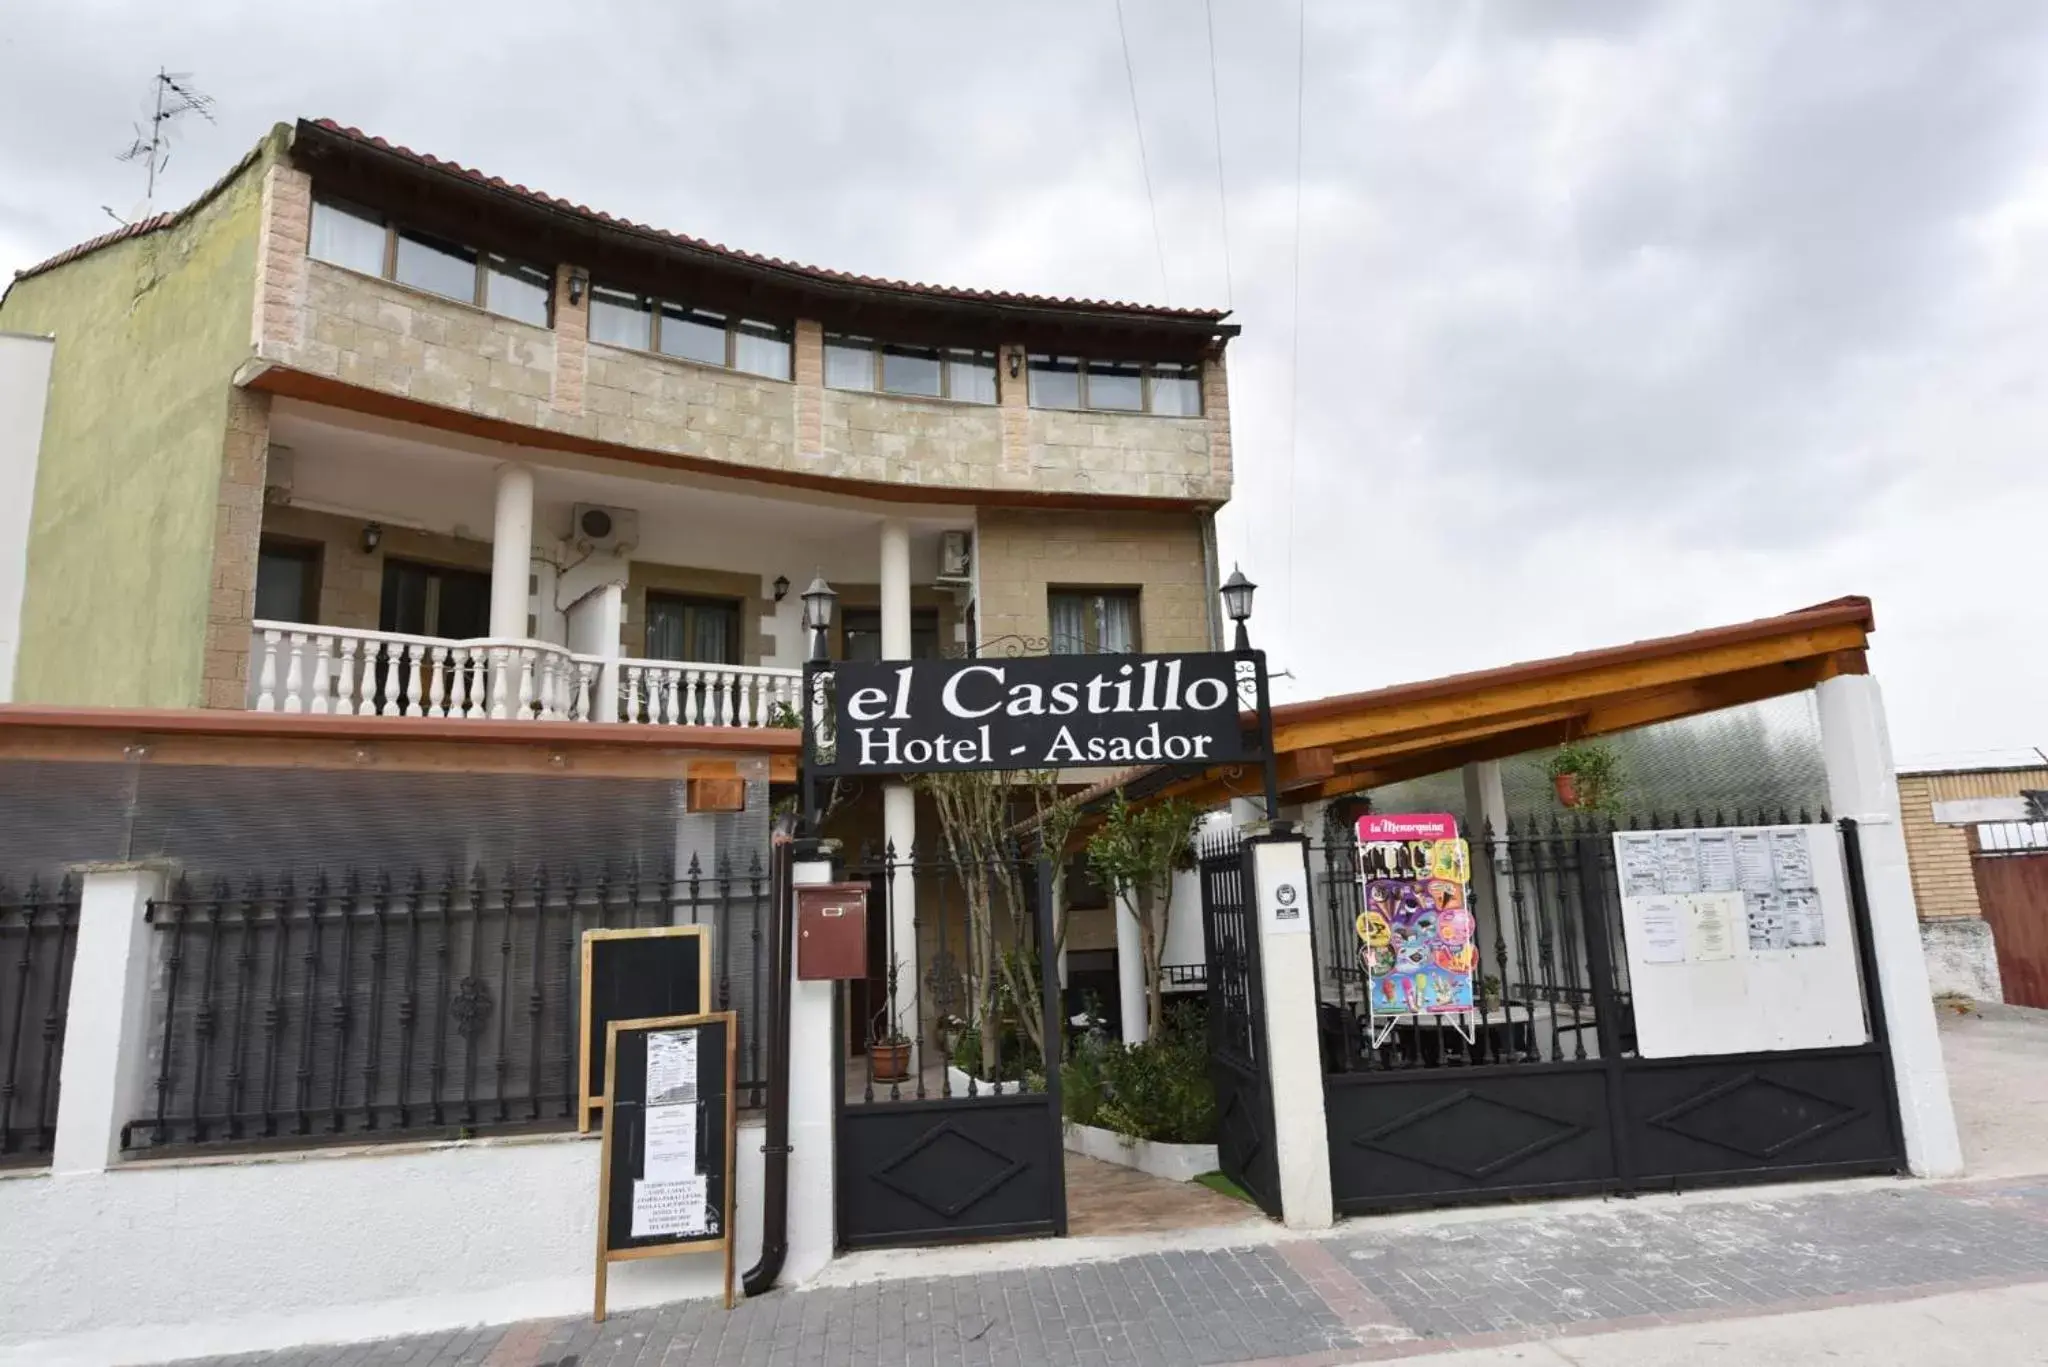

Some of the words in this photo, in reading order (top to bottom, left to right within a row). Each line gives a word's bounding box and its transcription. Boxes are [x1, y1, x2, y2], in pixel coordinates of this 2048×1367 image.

[847, 666, 914, 721] el
[941, 659, 1229, 719] Castillo
[855, 725, 994, 766] Hotel
[1043, 721, 1213, 763] Asador
